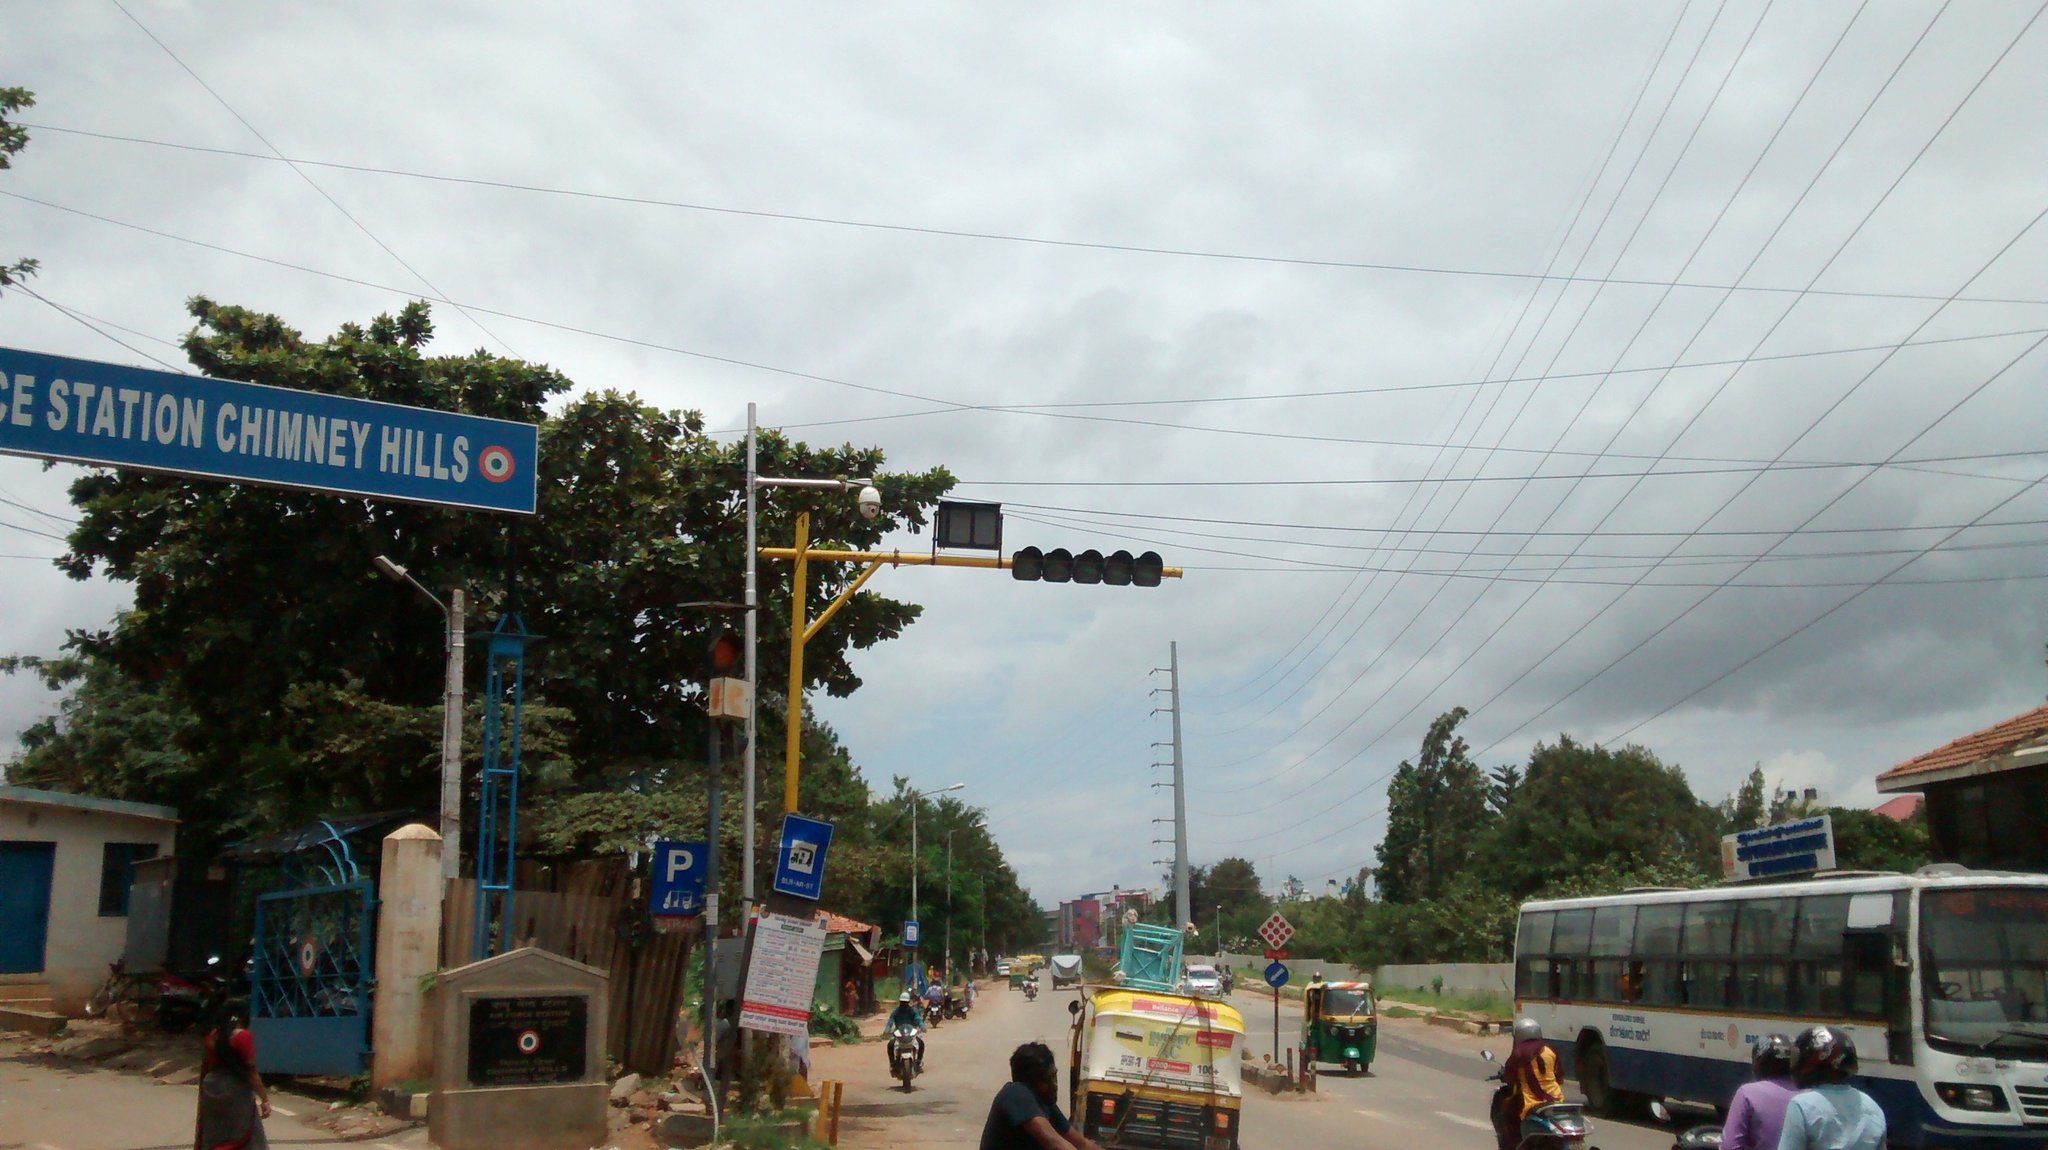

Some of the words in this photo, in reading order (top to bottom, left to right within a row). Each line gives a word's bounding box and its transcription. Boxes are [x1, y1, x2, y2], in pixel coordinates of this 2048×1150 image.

[46, 378, 205, 449] STATION
[216, 402, 371, 470] CHIMNEY
[380, 426, 470, 483] HILLS
[666, 849, 694, 883] P
